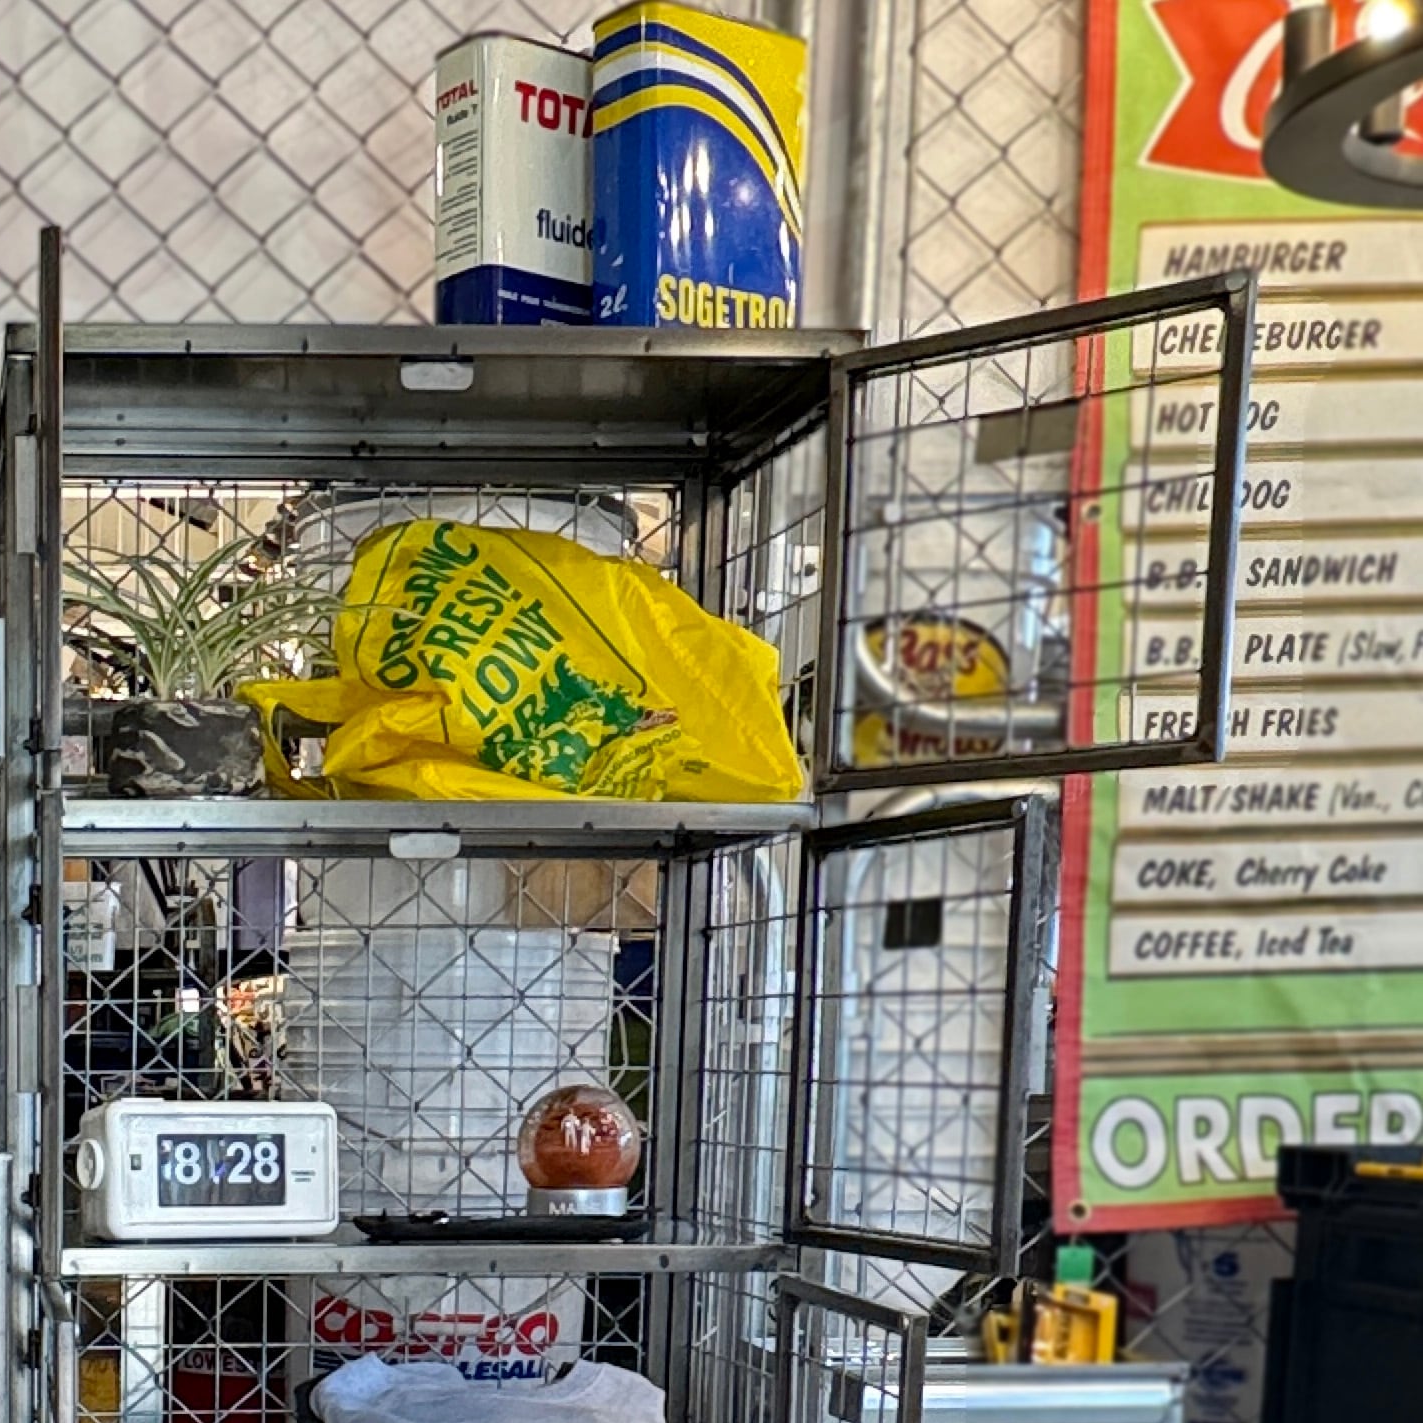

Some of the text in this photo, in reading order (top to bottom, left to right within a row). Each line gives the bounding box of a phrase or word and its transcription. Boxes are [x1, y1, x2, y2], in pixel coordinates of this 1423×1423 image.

[1163, 240, 1348, 277] HAMBURGER
[1155, 402, 1214, 434] HOT
[1246, 551, 1397, 588] SANDWICH
[1244, 632, 1328, 664] PLATE
[1261, 707, 1339, 738] FRIES
[1142, 782, 1320, 815] MALT/SHAKE
[1138, 854, 1388, 893] COKE, Cherry Coke
[1134, 926, 1355, 960] COFFEE, Iced Tea
[227, 1140, 280, 1185] 28
